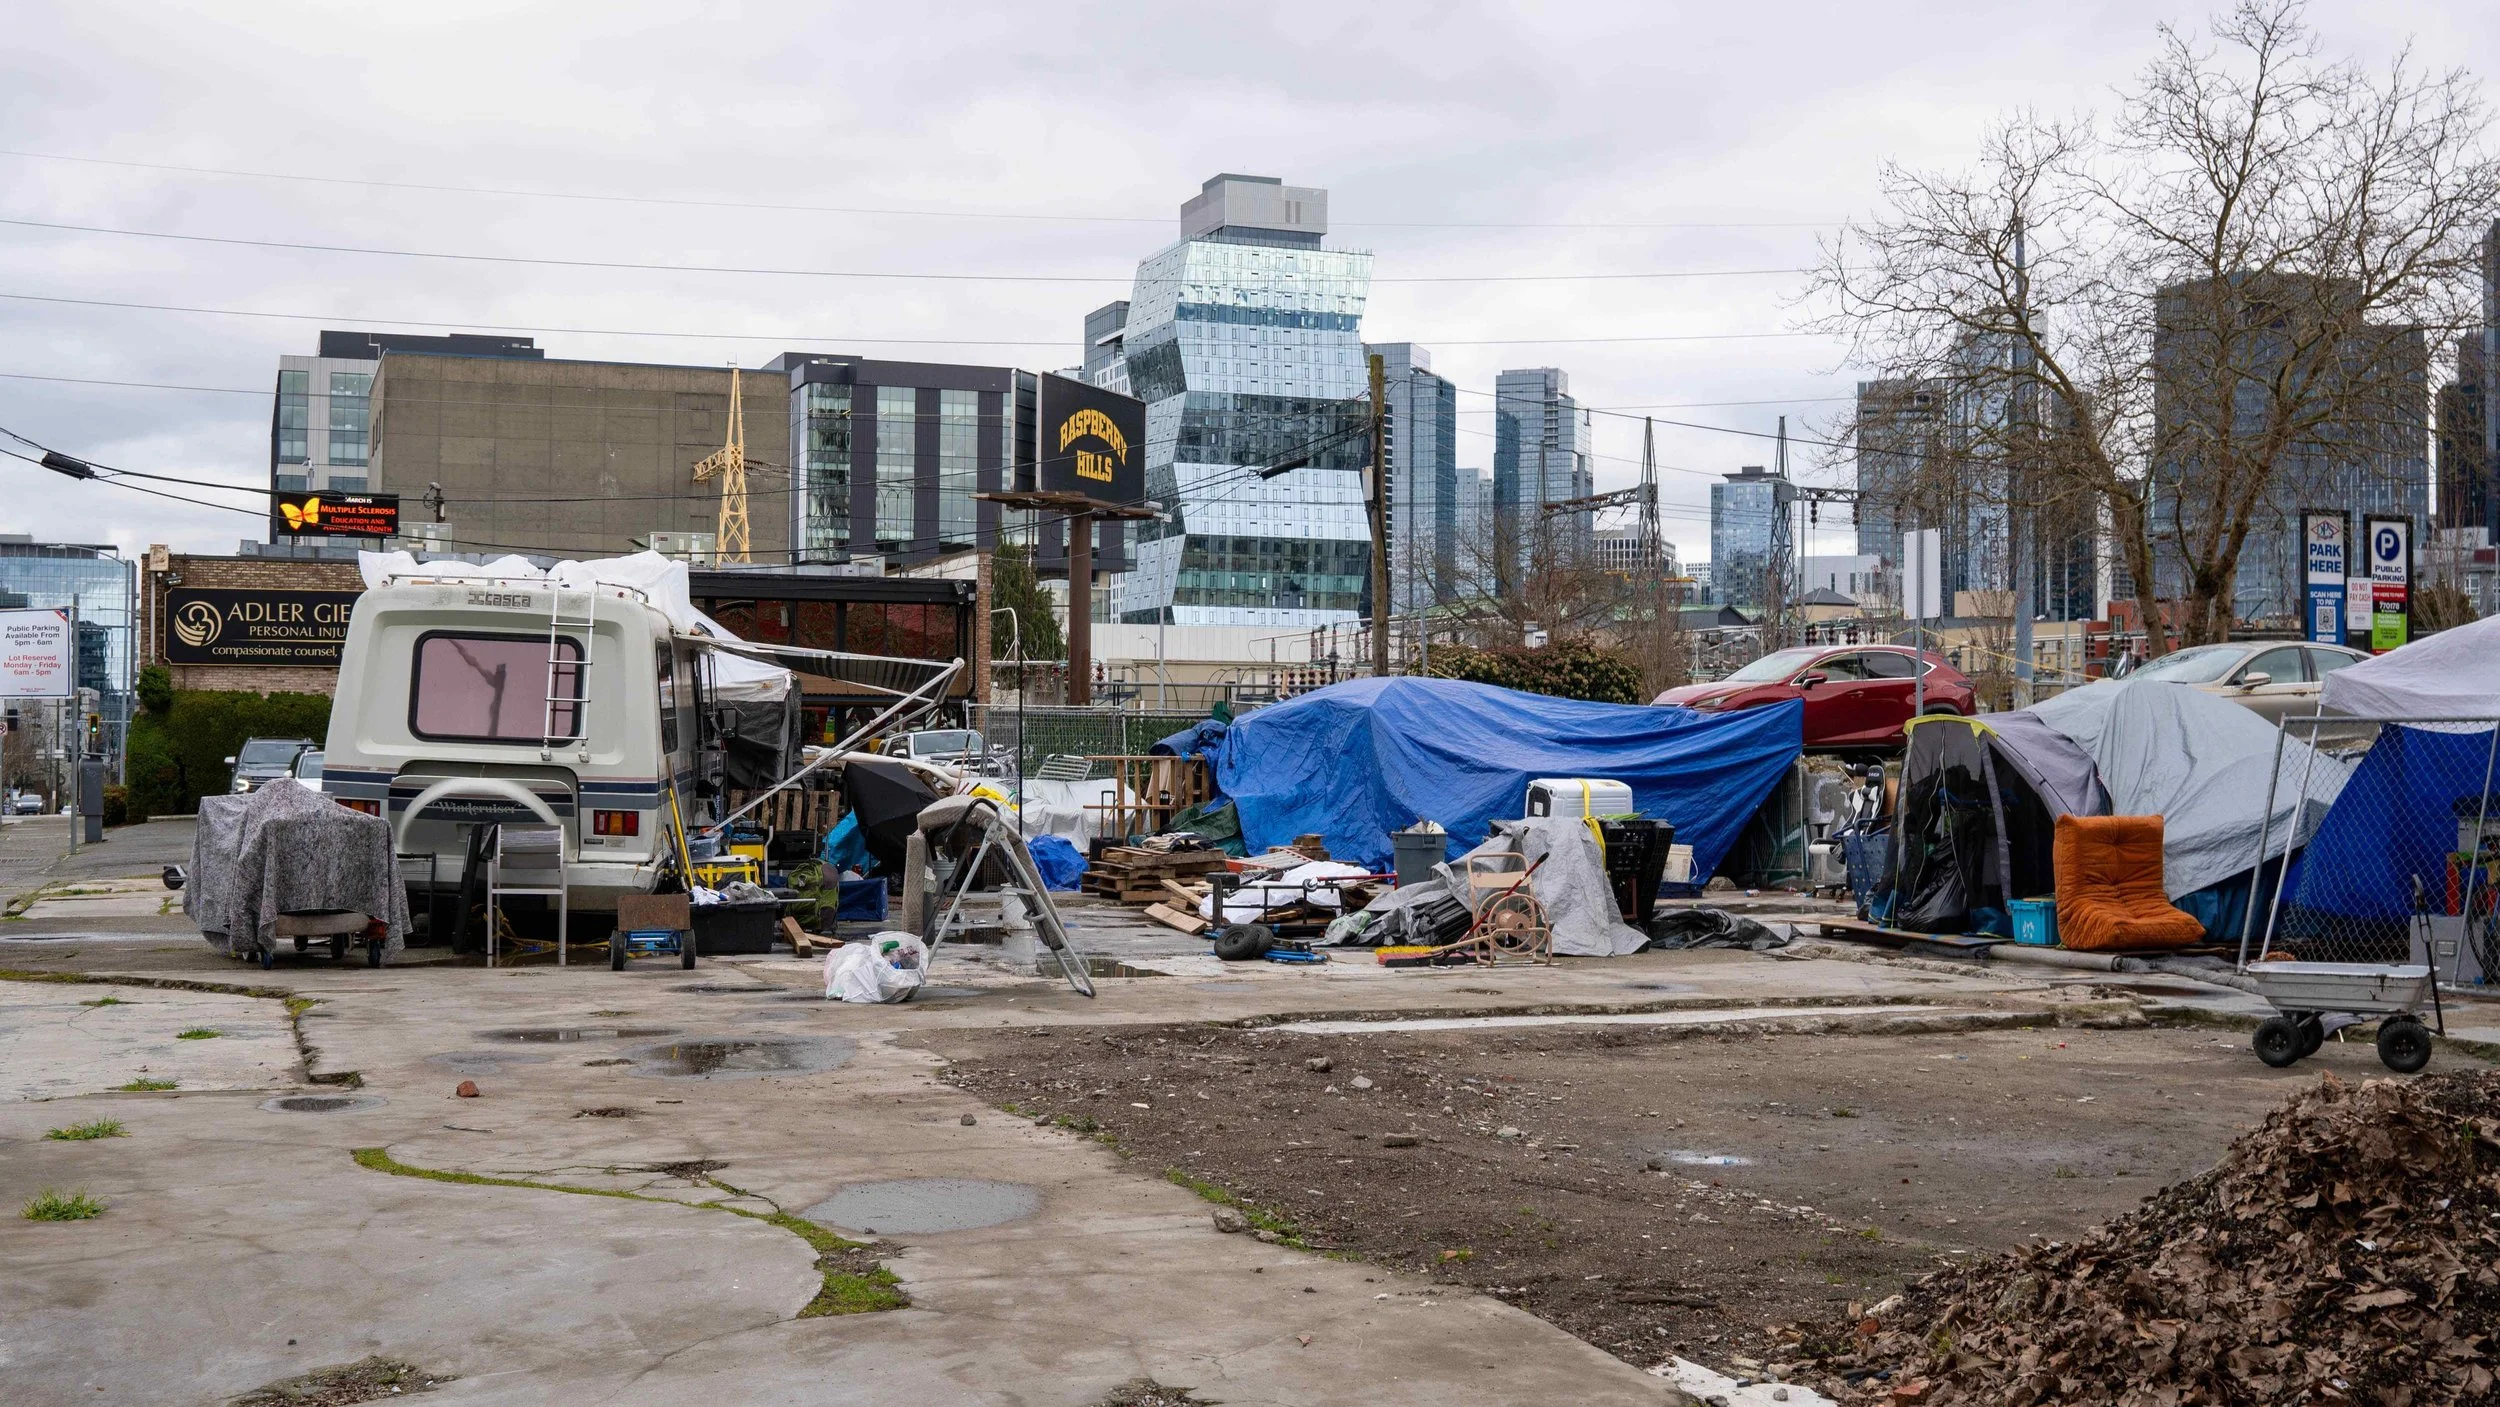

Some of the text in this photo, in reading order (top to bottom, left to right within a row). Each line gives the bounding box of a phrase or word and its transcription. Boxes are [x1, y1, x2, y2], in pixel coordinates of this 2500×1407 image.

[1060, 409, 1128, 466] RASPBERRY
[1077, 449, 1112, 483] HILLS
[321, 505, 396, 515] MULTIPLE SCLEROSIS
[331, 516, 369, 524] EDUCATION
[2310, 543, 2341, 557] PARK
[2381, 533, 2394, 556] P
[2310, 559, 2342, 573] HERE
[2375, 565, 2402, 573] PUBLIC
[2359, 583, 2368, 591] NOT
[2350, 592, 2371, 602] PAY CASH
[227, 602, 305, 622] ADLER
[2379, 602, 2400, 610] 770178
[249, 626, 314, 637] PERSONAL
[212, 645, 292, 658] compassionate
[294, 646, 338, 658] counsel,
